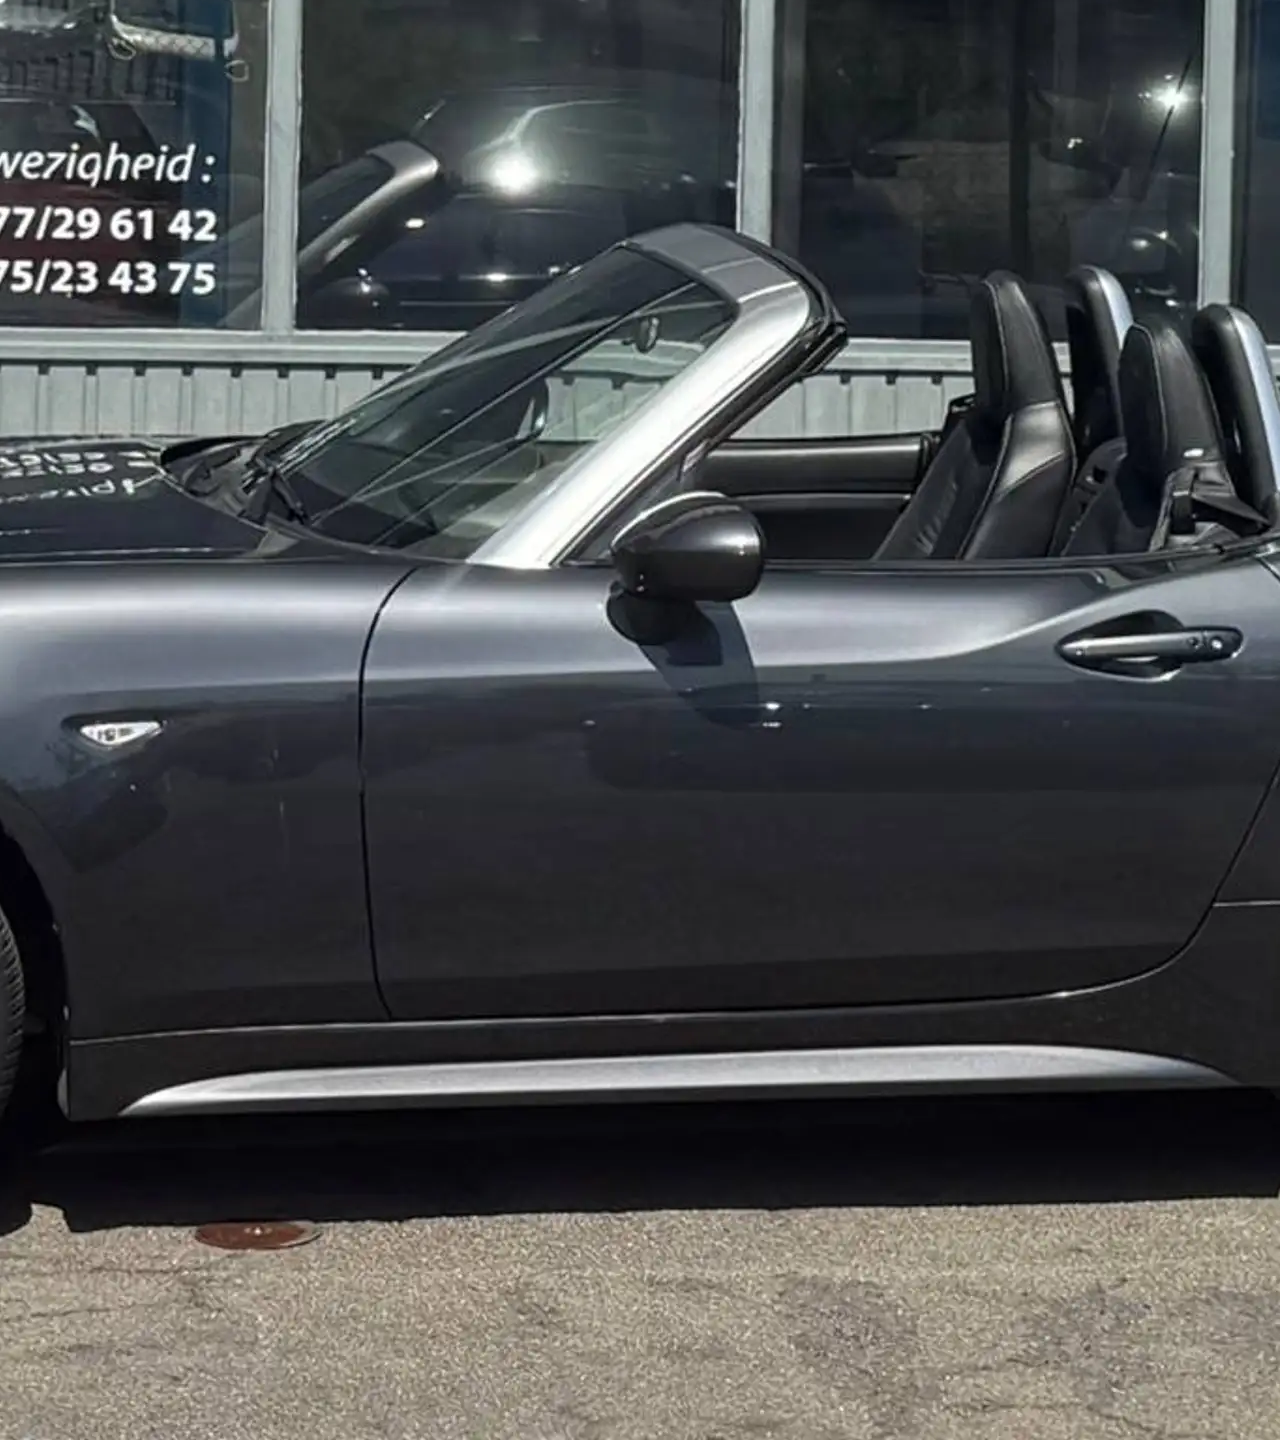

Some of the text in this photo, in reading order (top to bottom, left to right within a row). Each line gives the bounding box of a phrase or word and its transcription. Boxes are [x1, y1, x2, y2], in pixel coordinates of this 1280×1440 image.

[109, 208, 155, 241] 61
[168, 209, 217, 242] 42
[107, 262, 157, 295] 43
[168, 262, 217, 295] 75
